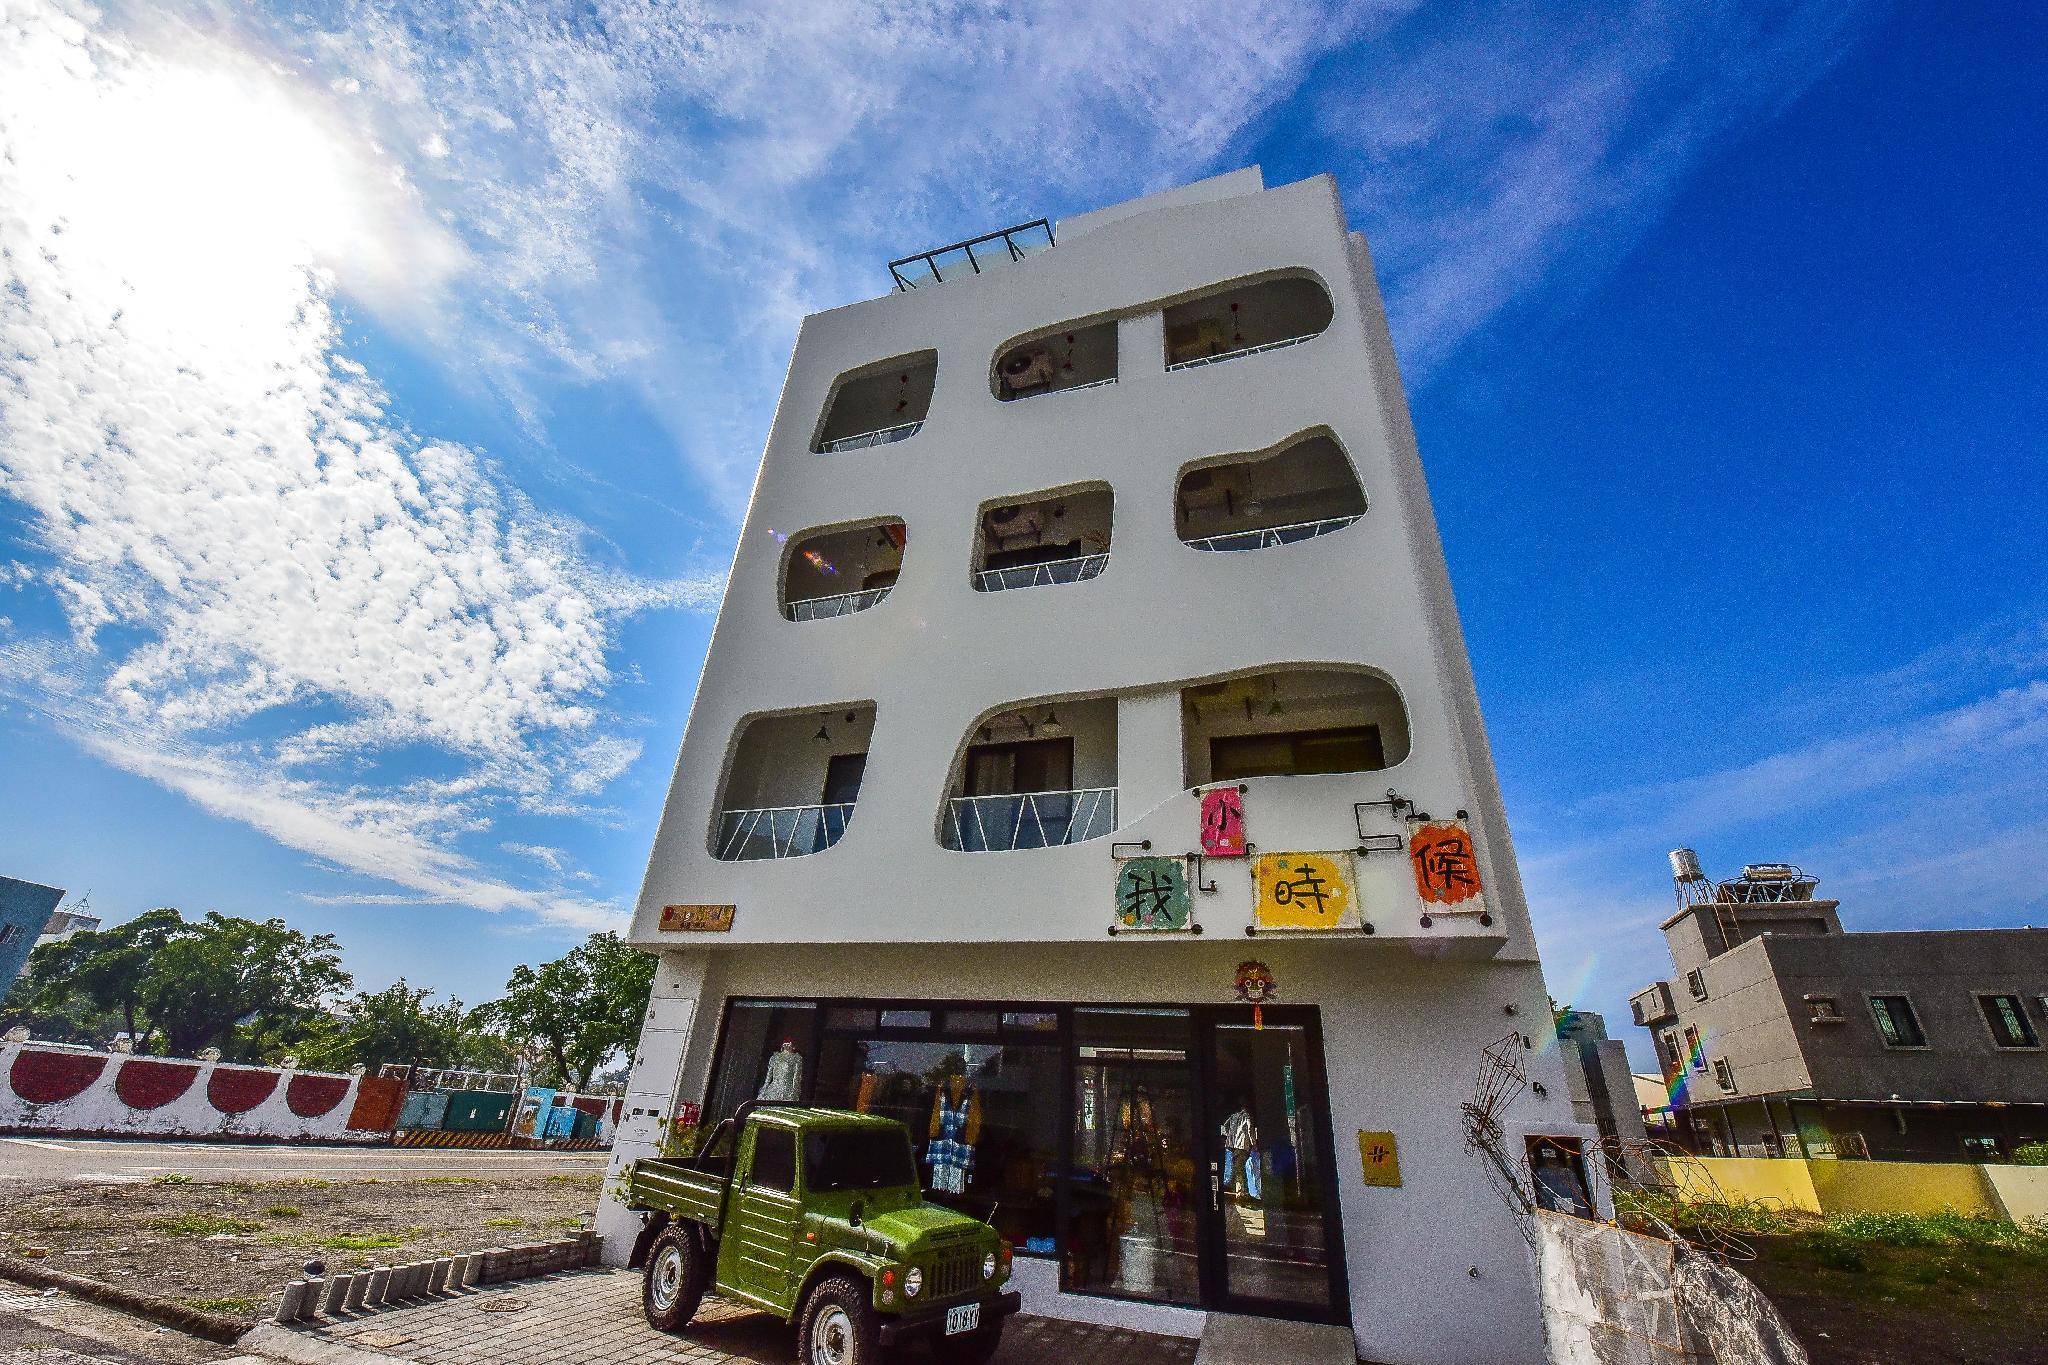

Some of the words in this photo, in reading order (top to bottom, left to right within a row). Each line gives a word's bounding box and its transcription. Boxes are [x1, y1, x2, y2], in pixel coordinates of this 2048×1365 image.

[1125, 871, 1174, 921] 我
[1207, 800, 1241, 831] 小
[1275, 863, 1330, 914] 時
[1415, 838, 1475, 889] 候
